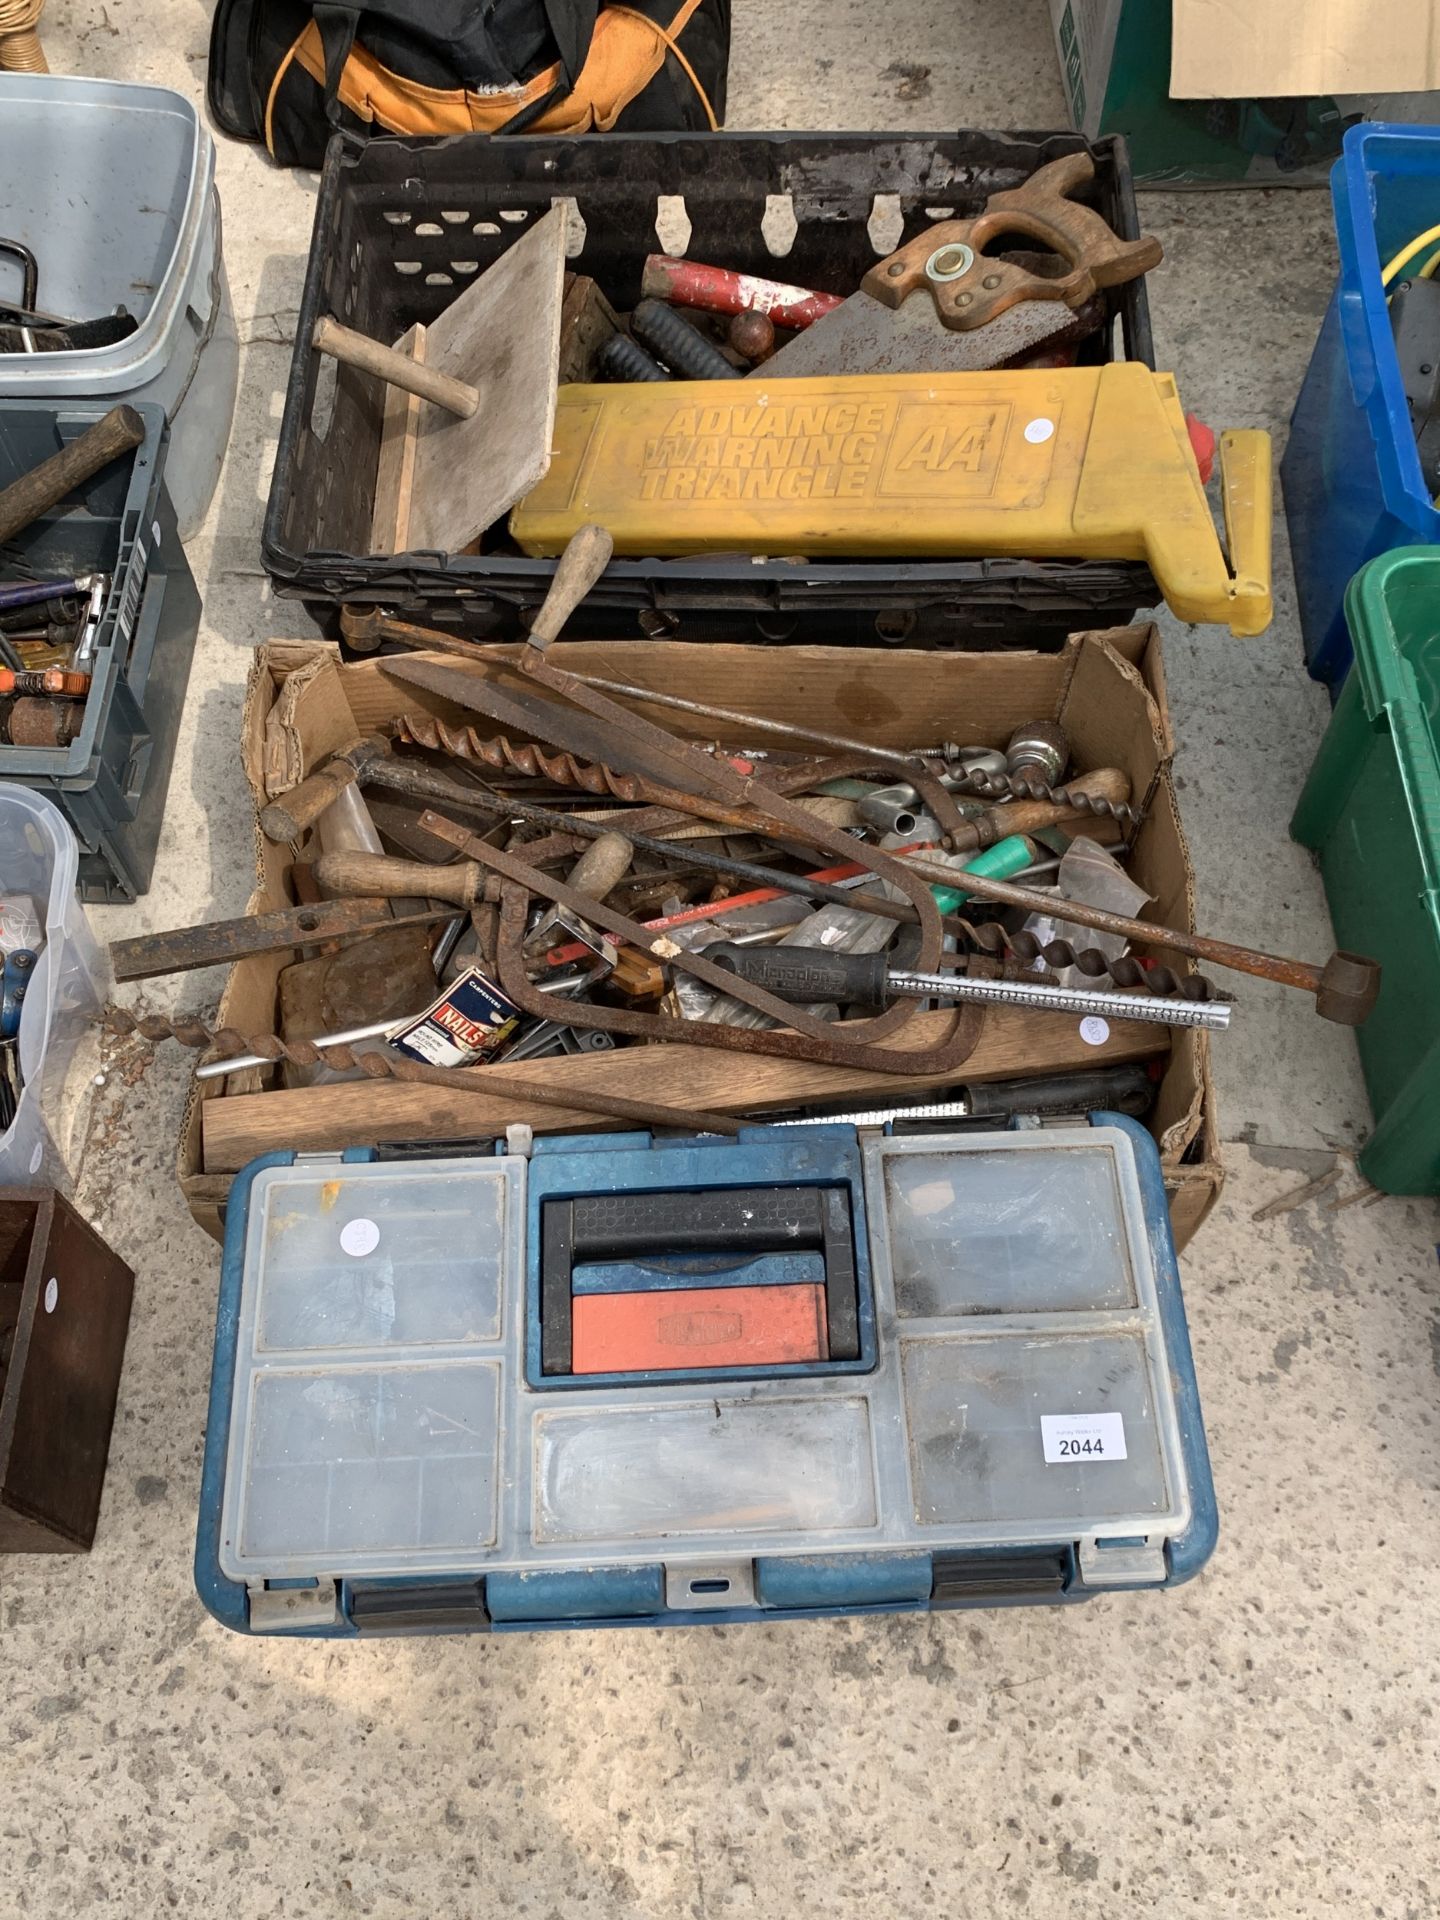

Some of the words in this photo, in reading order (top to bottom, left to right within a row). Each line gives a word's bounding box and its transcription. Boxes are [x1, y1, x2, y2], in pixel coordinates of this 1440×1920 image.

[664, 402, 888, 438] ADVANCE
[642, 431, 877, 468] WARNING
[896, 425, 985, 472] AA
[640, 463, 871, 500] TRIANGLE
[468, 980, 502, 1009] CARPENTERS
[438, 1007, 484, 1045] NAILS
[1059, 1438, 1105, 1456] 2044
